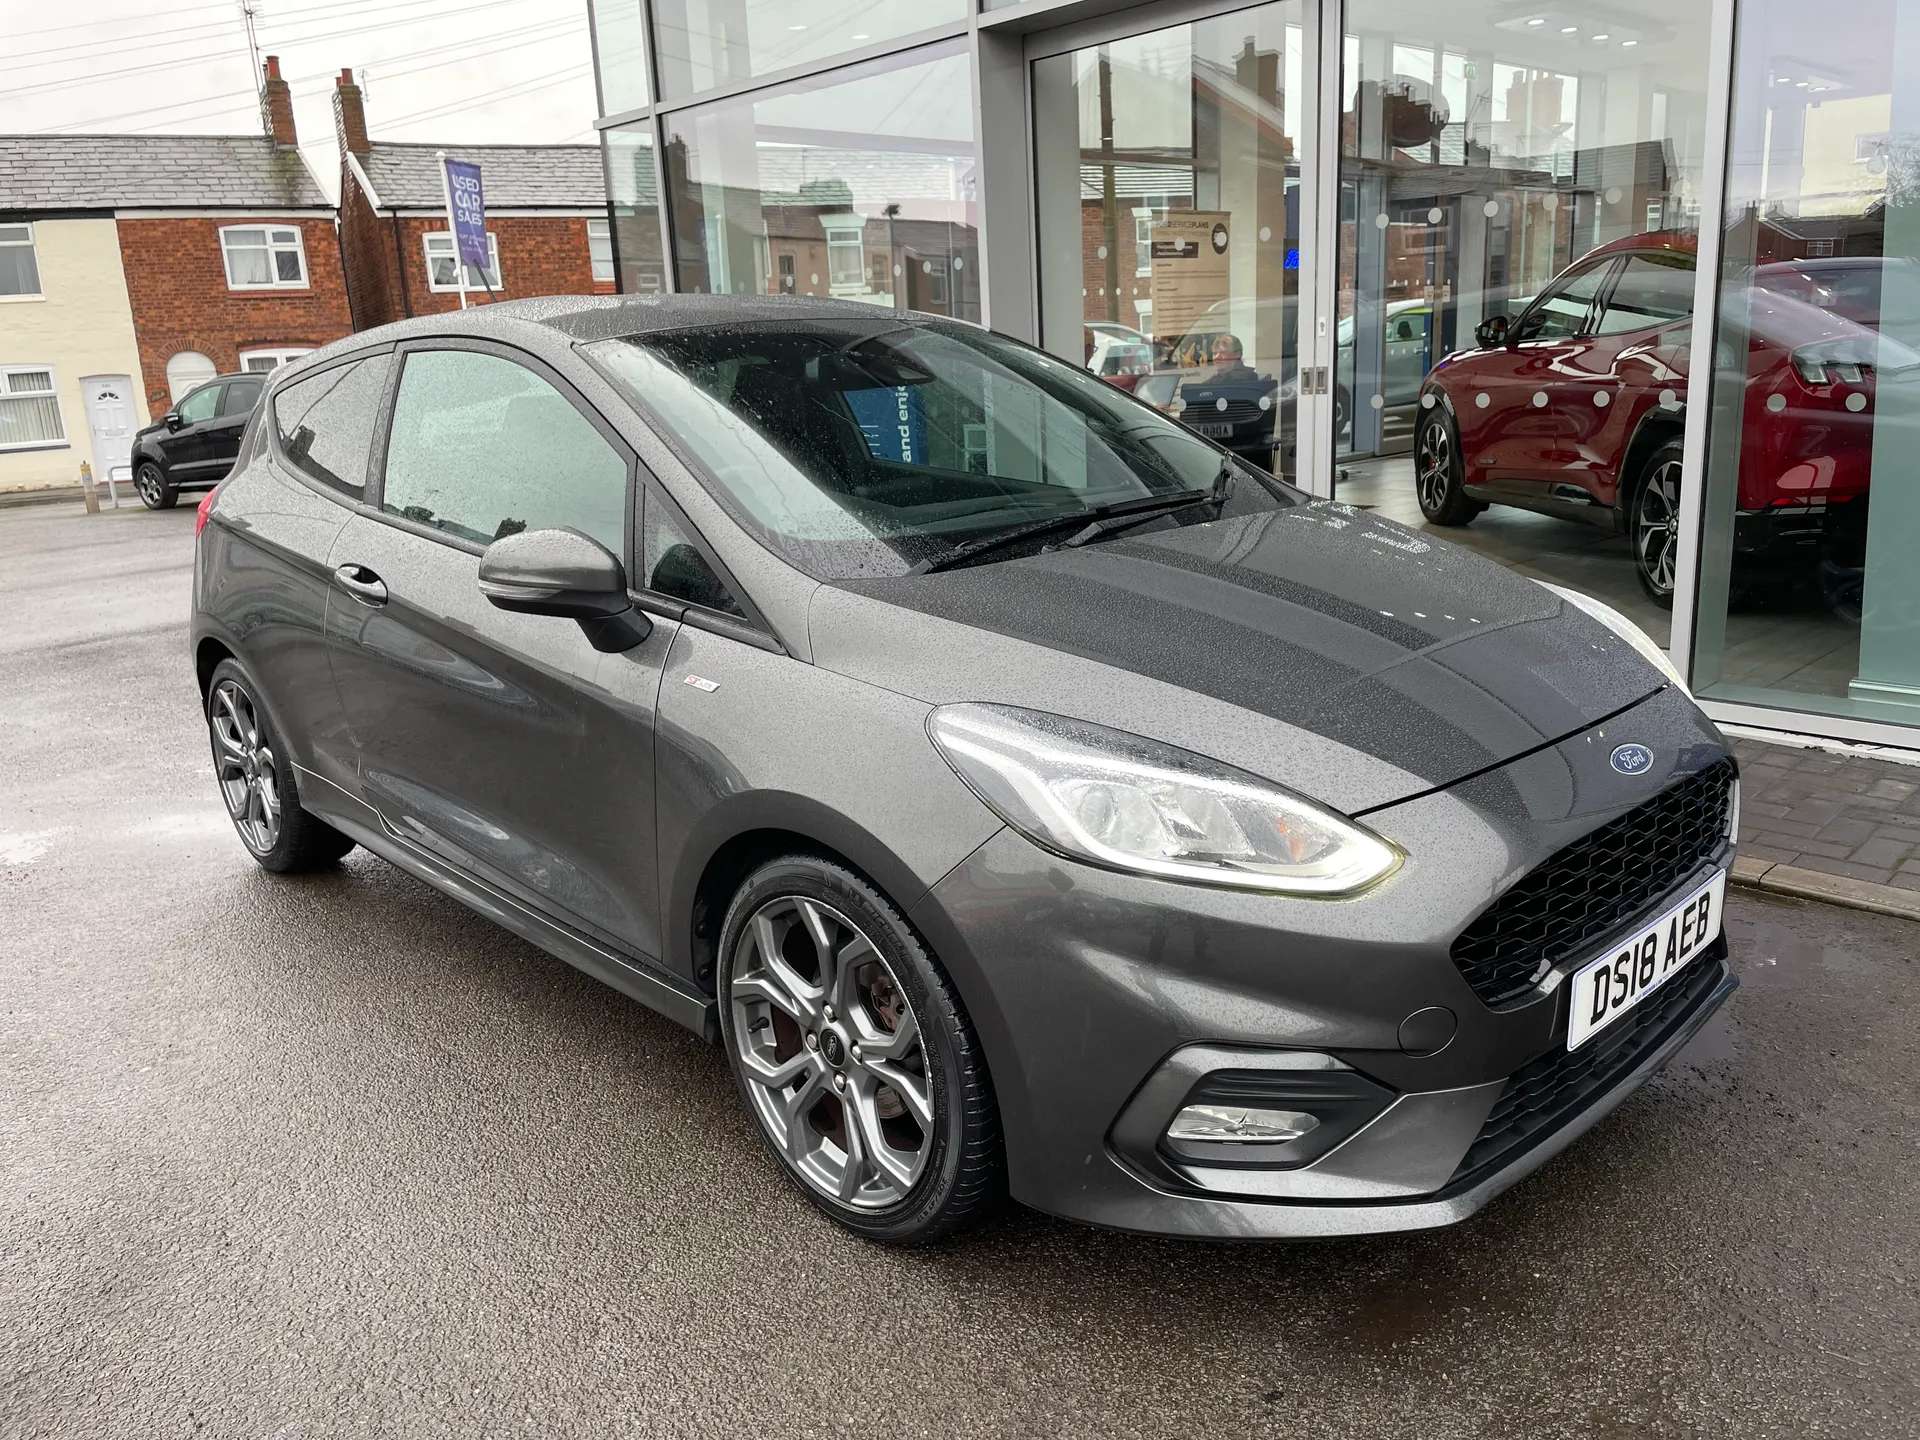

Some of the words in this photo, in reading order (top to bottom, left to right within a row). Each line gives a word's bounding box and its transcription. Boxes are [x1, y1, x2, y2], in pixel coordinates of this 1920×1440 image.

[451, 174, 480, 192] USED
[455, 190, 480, 212] CAR
[458, 210, 482, 226] SAES
[898, 425, 912, 463] and
[1619, 750, 1645, 769] Ford
[1590, 932, 1658, 1026] DS18
[1663, 891, 1711, 973] AEB
